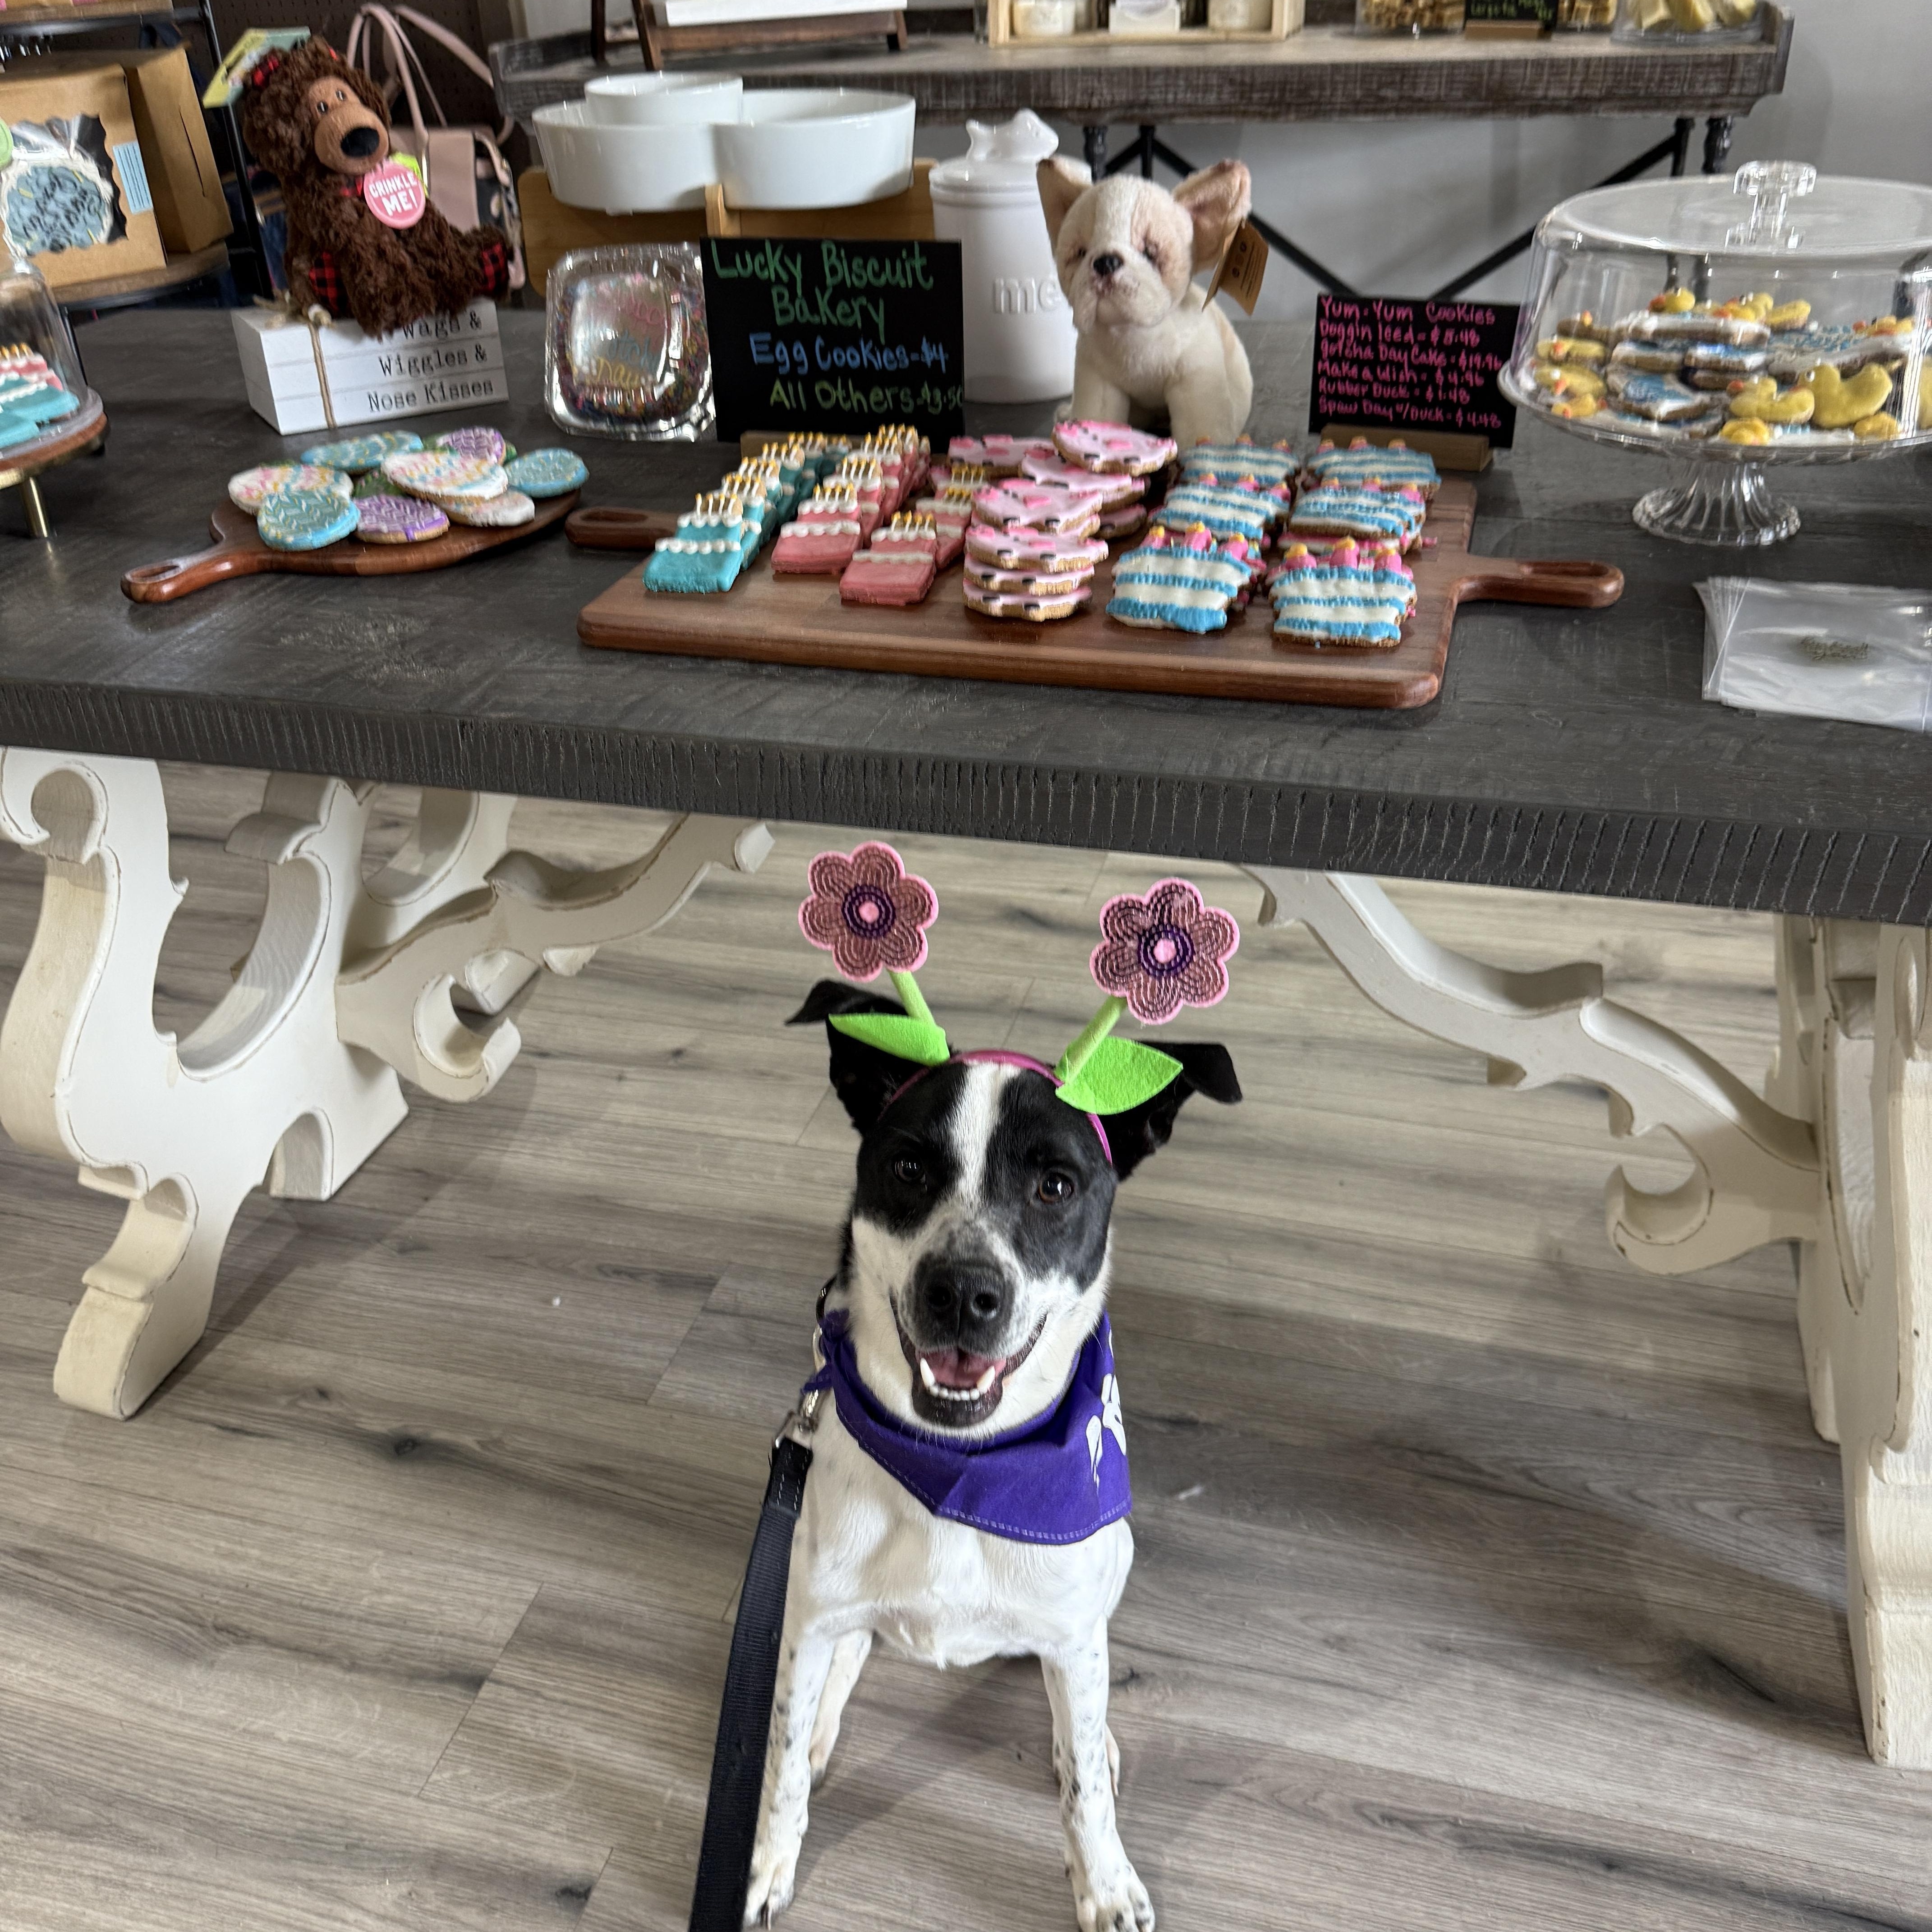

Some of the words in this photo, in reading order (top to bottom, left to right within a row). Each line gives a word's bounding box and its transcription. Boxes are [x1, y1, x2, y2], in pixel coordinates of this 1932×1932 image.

[368, 171, 418, 198] CRINKLE
[382, 188, 418, 216] ME!
[711, 238, 802, 297] Lucky
[821, 240, 934, 290] Biscuit
[470, 310, 482, 330] &
[771, 284, 885, 345] Bakery
[1426, 301, 1495, 325] Cookies
[378, 349, 468, 377] Wiggles
[475, 343, 487, 362] &
[749, 332, 809, 375] Egg
[1378, 343, 1408, 368] Day
[1411, 343, 1447, 367] Cake
[1318, 359, 1358, 379] Make
[1362, 366, 1374, 382] a
[367, 391, 417, 412] Nose
[425, 381, 493, 405] Kisses
[770, 377, 806, 411] All
[1319, 377, 1368, 397] Rubber
[1373, 382, 1410, 398] Duck
[1363, 399, 1393, 422] Day
